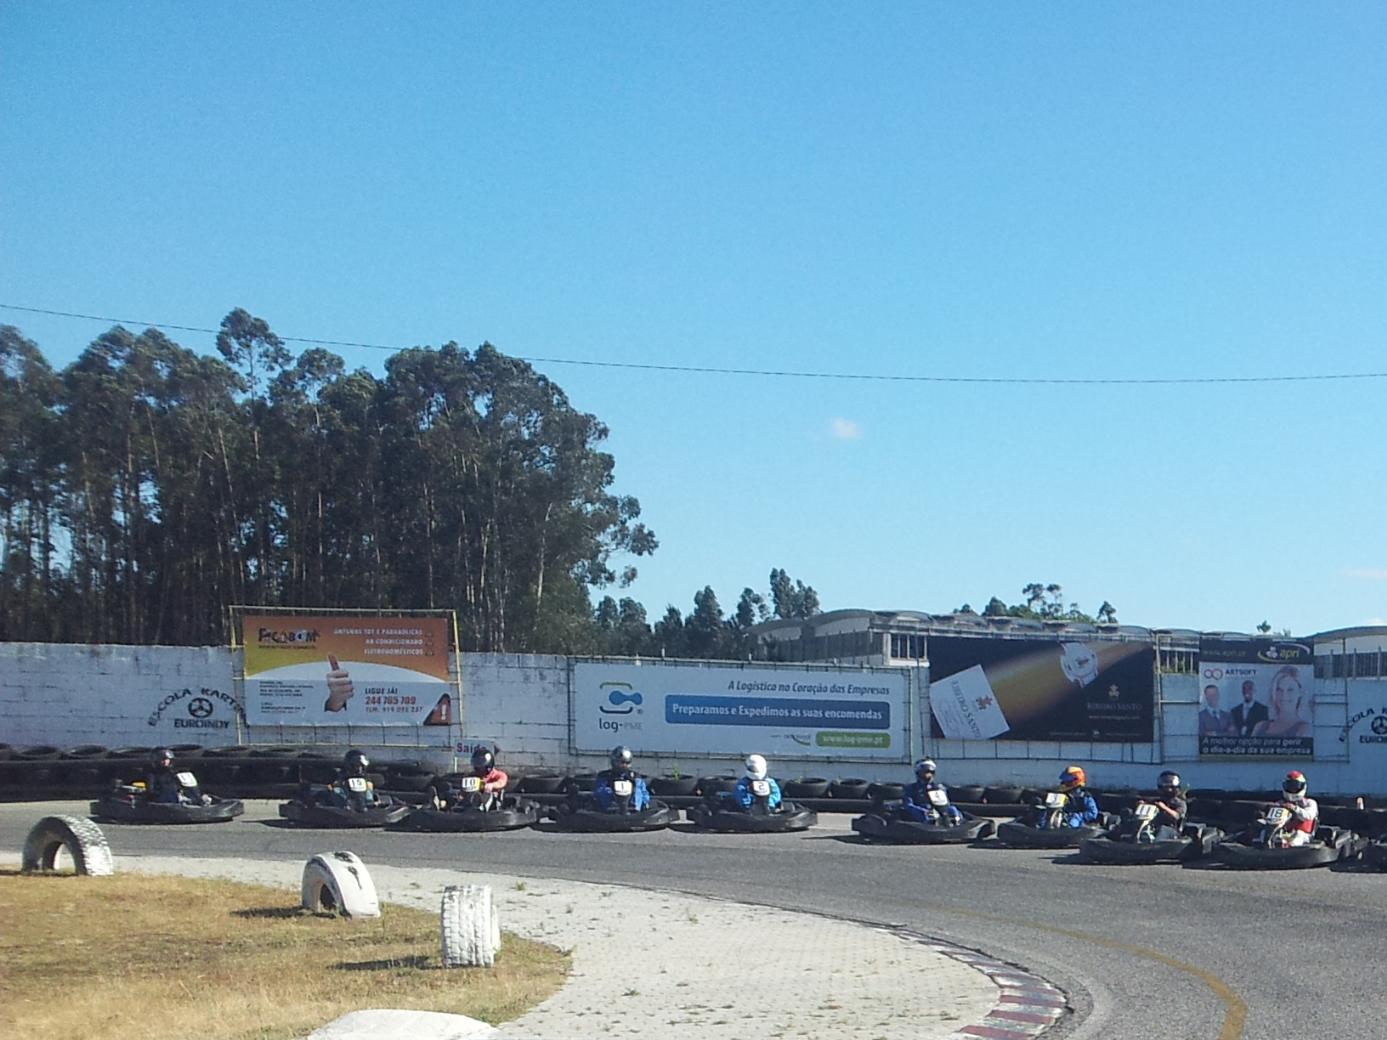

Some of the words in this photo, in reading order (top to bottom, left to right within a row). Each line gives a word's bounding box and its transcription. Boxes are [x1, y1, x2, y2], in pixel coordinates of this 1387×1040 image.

[728, 680, 735, 691] A
[778, 683, 790, 692] no
[847, 684, 890, 697] Empresas
[148, 688, 192, 727] ESCOLA
[672, 703, 729, 717] Preparamos
[738, 705, 789, 718] Expedimos
[790, 708, 801, 718] as
[803, 709, 823, 718] suas
[825, 708, 883, 720] encomendas
[174, 718, 230, 729] EUROINDY
[1268, 807, 1283, 819] 18
